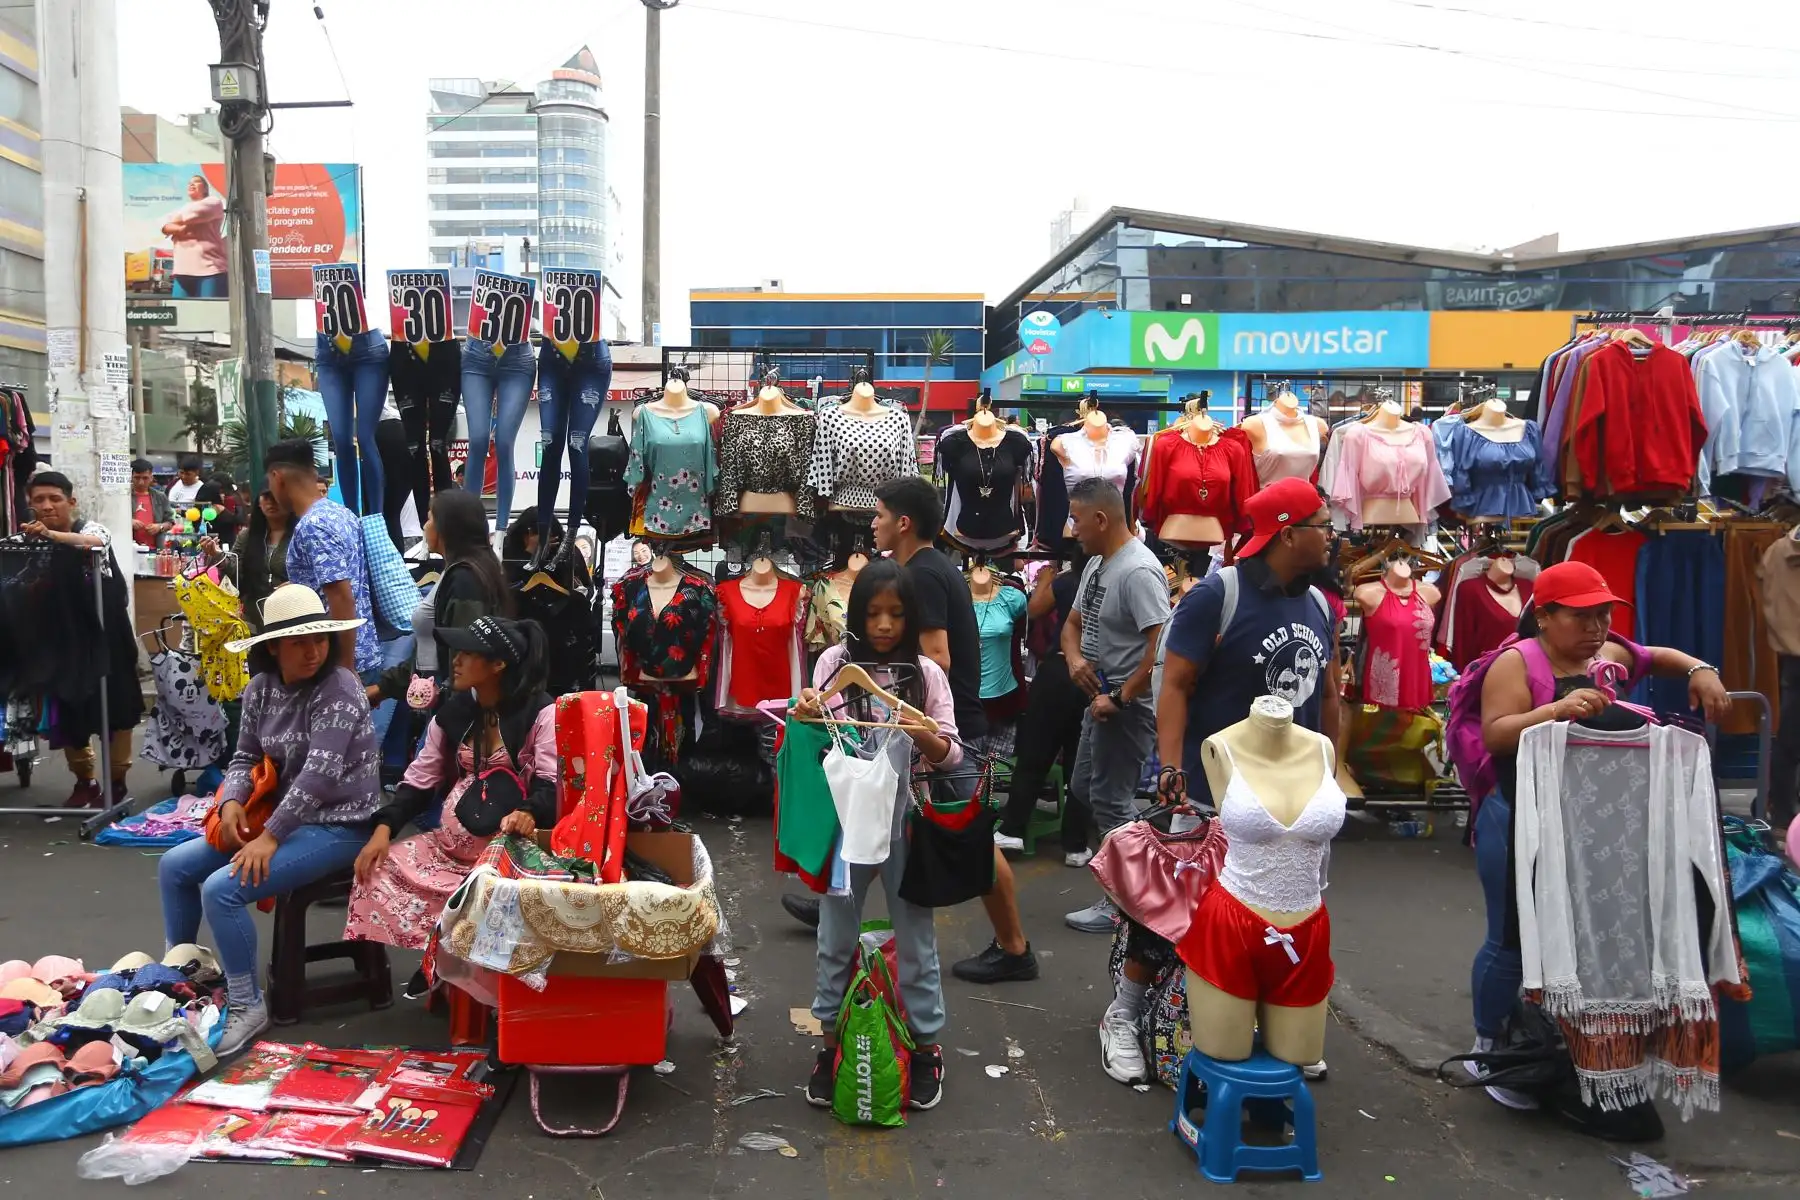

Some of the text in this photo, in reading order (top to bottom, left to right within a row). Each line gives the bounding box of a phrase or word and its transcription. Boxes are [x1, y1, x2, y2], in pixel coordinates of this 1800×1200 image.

[292, 205, 315, 216] gratis
[274, 218, 313, 227] programa
[269, 244, 312, 254] rendedor
[315, 267, 356, 283] OFERTA
[391, 272, 446, 287] OFERTA
[546, 271, 596, 287] OFERTA
[477, 272, 530, 296] OFERTA
[1233, 326, 1388, 355] movistar
[1261, 622, 1324, 657] OLD SCHOOL
[856, 1051, 873, 1122] TOTTUS
